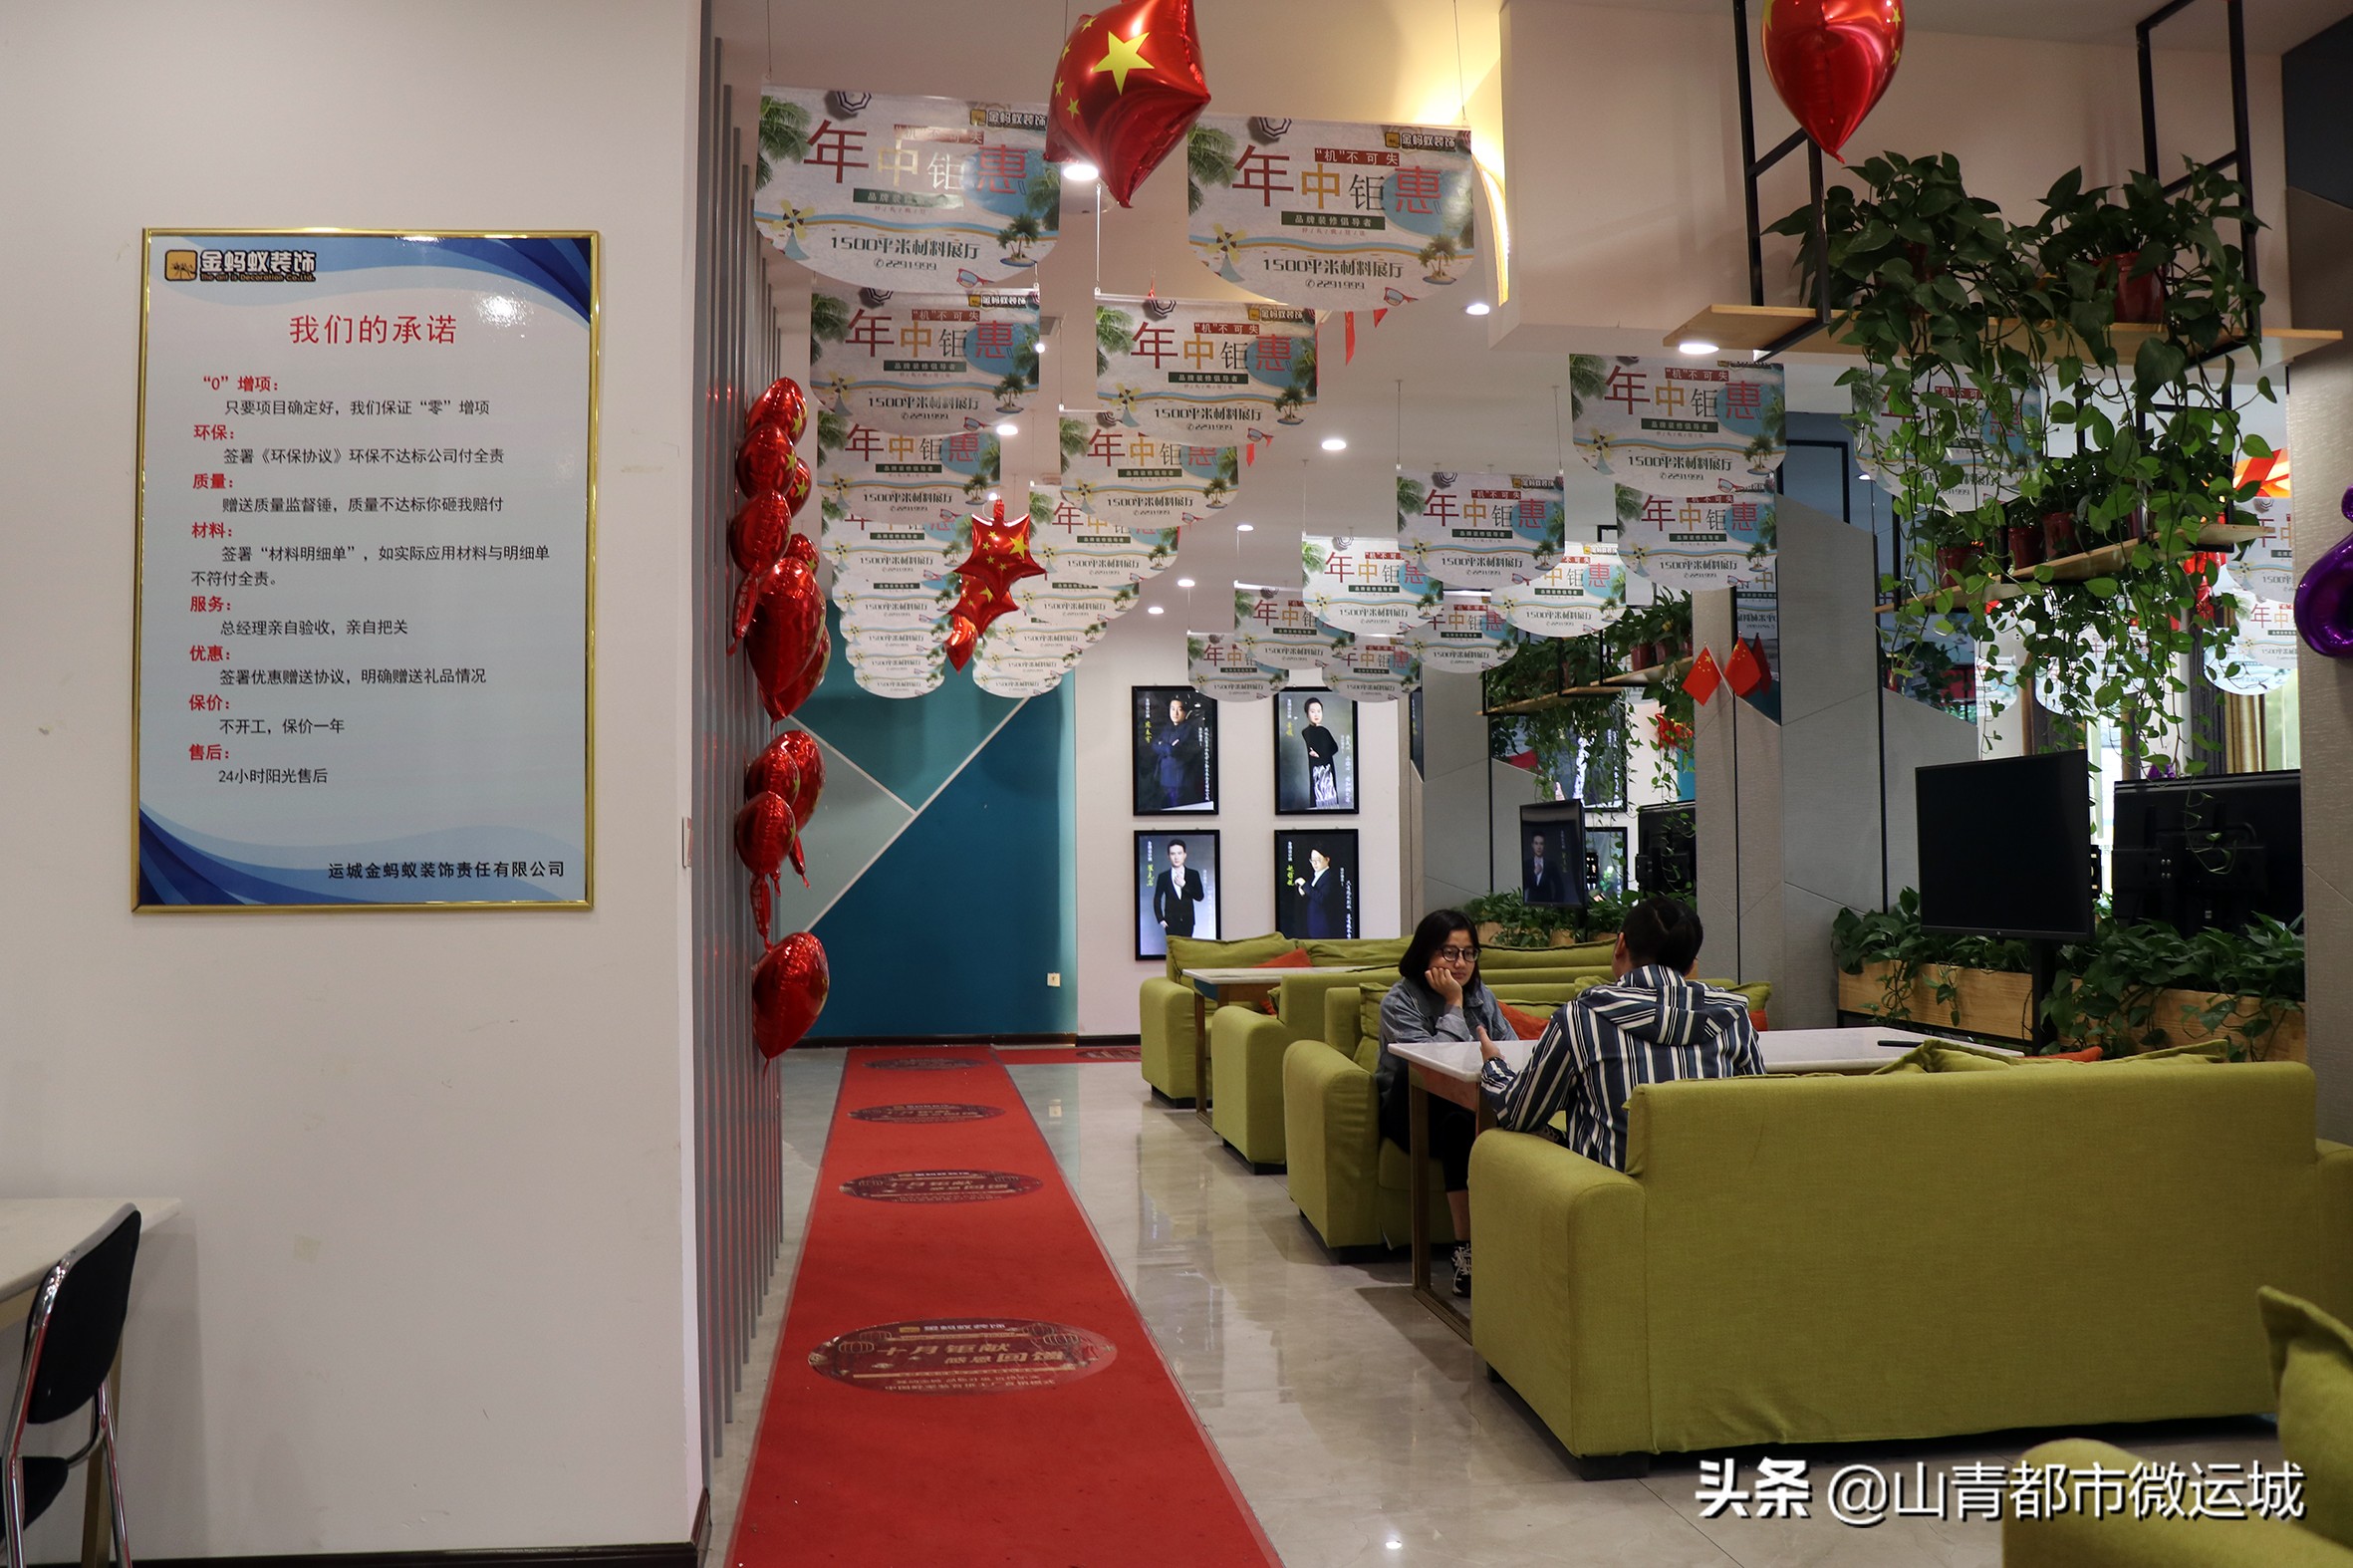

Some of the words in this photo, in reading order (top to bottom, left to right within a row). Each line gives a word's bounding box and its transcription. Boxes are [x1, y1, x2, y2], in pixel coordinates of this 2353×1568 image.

[987, 110, 1047, 129] 金蚂蚁装饰
[1401, 132, 1456, 148] 金蚂蚁装饰
[804, 120, 1027, 194] 年中钜惠
[1316, 148, 1399, 165] “机”不可失
[1232, 144, 1441, 214] 年中钜惠
[1295, 214, 1373, 227] 品牌装修倡导者
[831, 236, 981, 260] 1500平米材料展厅
[201, 251, 316, 273] 金蚂蚁装饰
[886, 260, 937, 272] 2291999
[1263, 259, 1404, 278] 1500平米材料展厅
[1316, 279, 1365, 290] 2291999
[290, 314, 457, 345] 我们的承诺
[845, 309, 1013, 359] 年中钜惠
[1131, 322, 1291, 371] 年中钜惠
[1666, 368, 1728, 381] “机”不可失
[1605, 366, 1761, 419] 年中钜惠
[224, 399, 490, 416] 只要项目确定好，我们保证“零”增项
[869, 396, 979, 410] 1500平米材料展厅
[1155, 407, 1261, 420] 1500平米材料展厅
[193, 424, 235, 441] 环保：
[845, 423, 978, 462] 年中钜惠
[1088, 429, 1217, 466] 年中钜惠
[223, 447, 504, 465] 签署《环保协议》环保不达标公司付全责
[1629, 455, 1732, 471] 1500平米材料展厅
[192, 473, 234, 490] 质量：
[222, 496, 504, 514] 赠送质量监督锤，质量不达标你砸我赔付
[1424, 489, 1546, 528] 年中钜惠
[1641, 495, 1757, 531] 年中钜惠
[191, 522, 233, 539] 材料：
[190, 570, 279, 587] 不符付全责。
[190, 596, 232, 613] 服务：
[220, 620, 408, 637] 总经理亲自验收，亲自把关
[189, 646, 231, 661] 优惠：
[219, 668, 486, 685] 签署优惠赠送协议，明确赠送礼品情况
[188, 694, 230, 711] 保价：
[219, 718, 345, 735] 不开工，保价一年
[188, 744, 230, 761] 售后：
[218, 767, 328, 784] 24小时阳光售后
[328, 861, 565, 879] 运城金蚂蚁装饰责任有限公司
